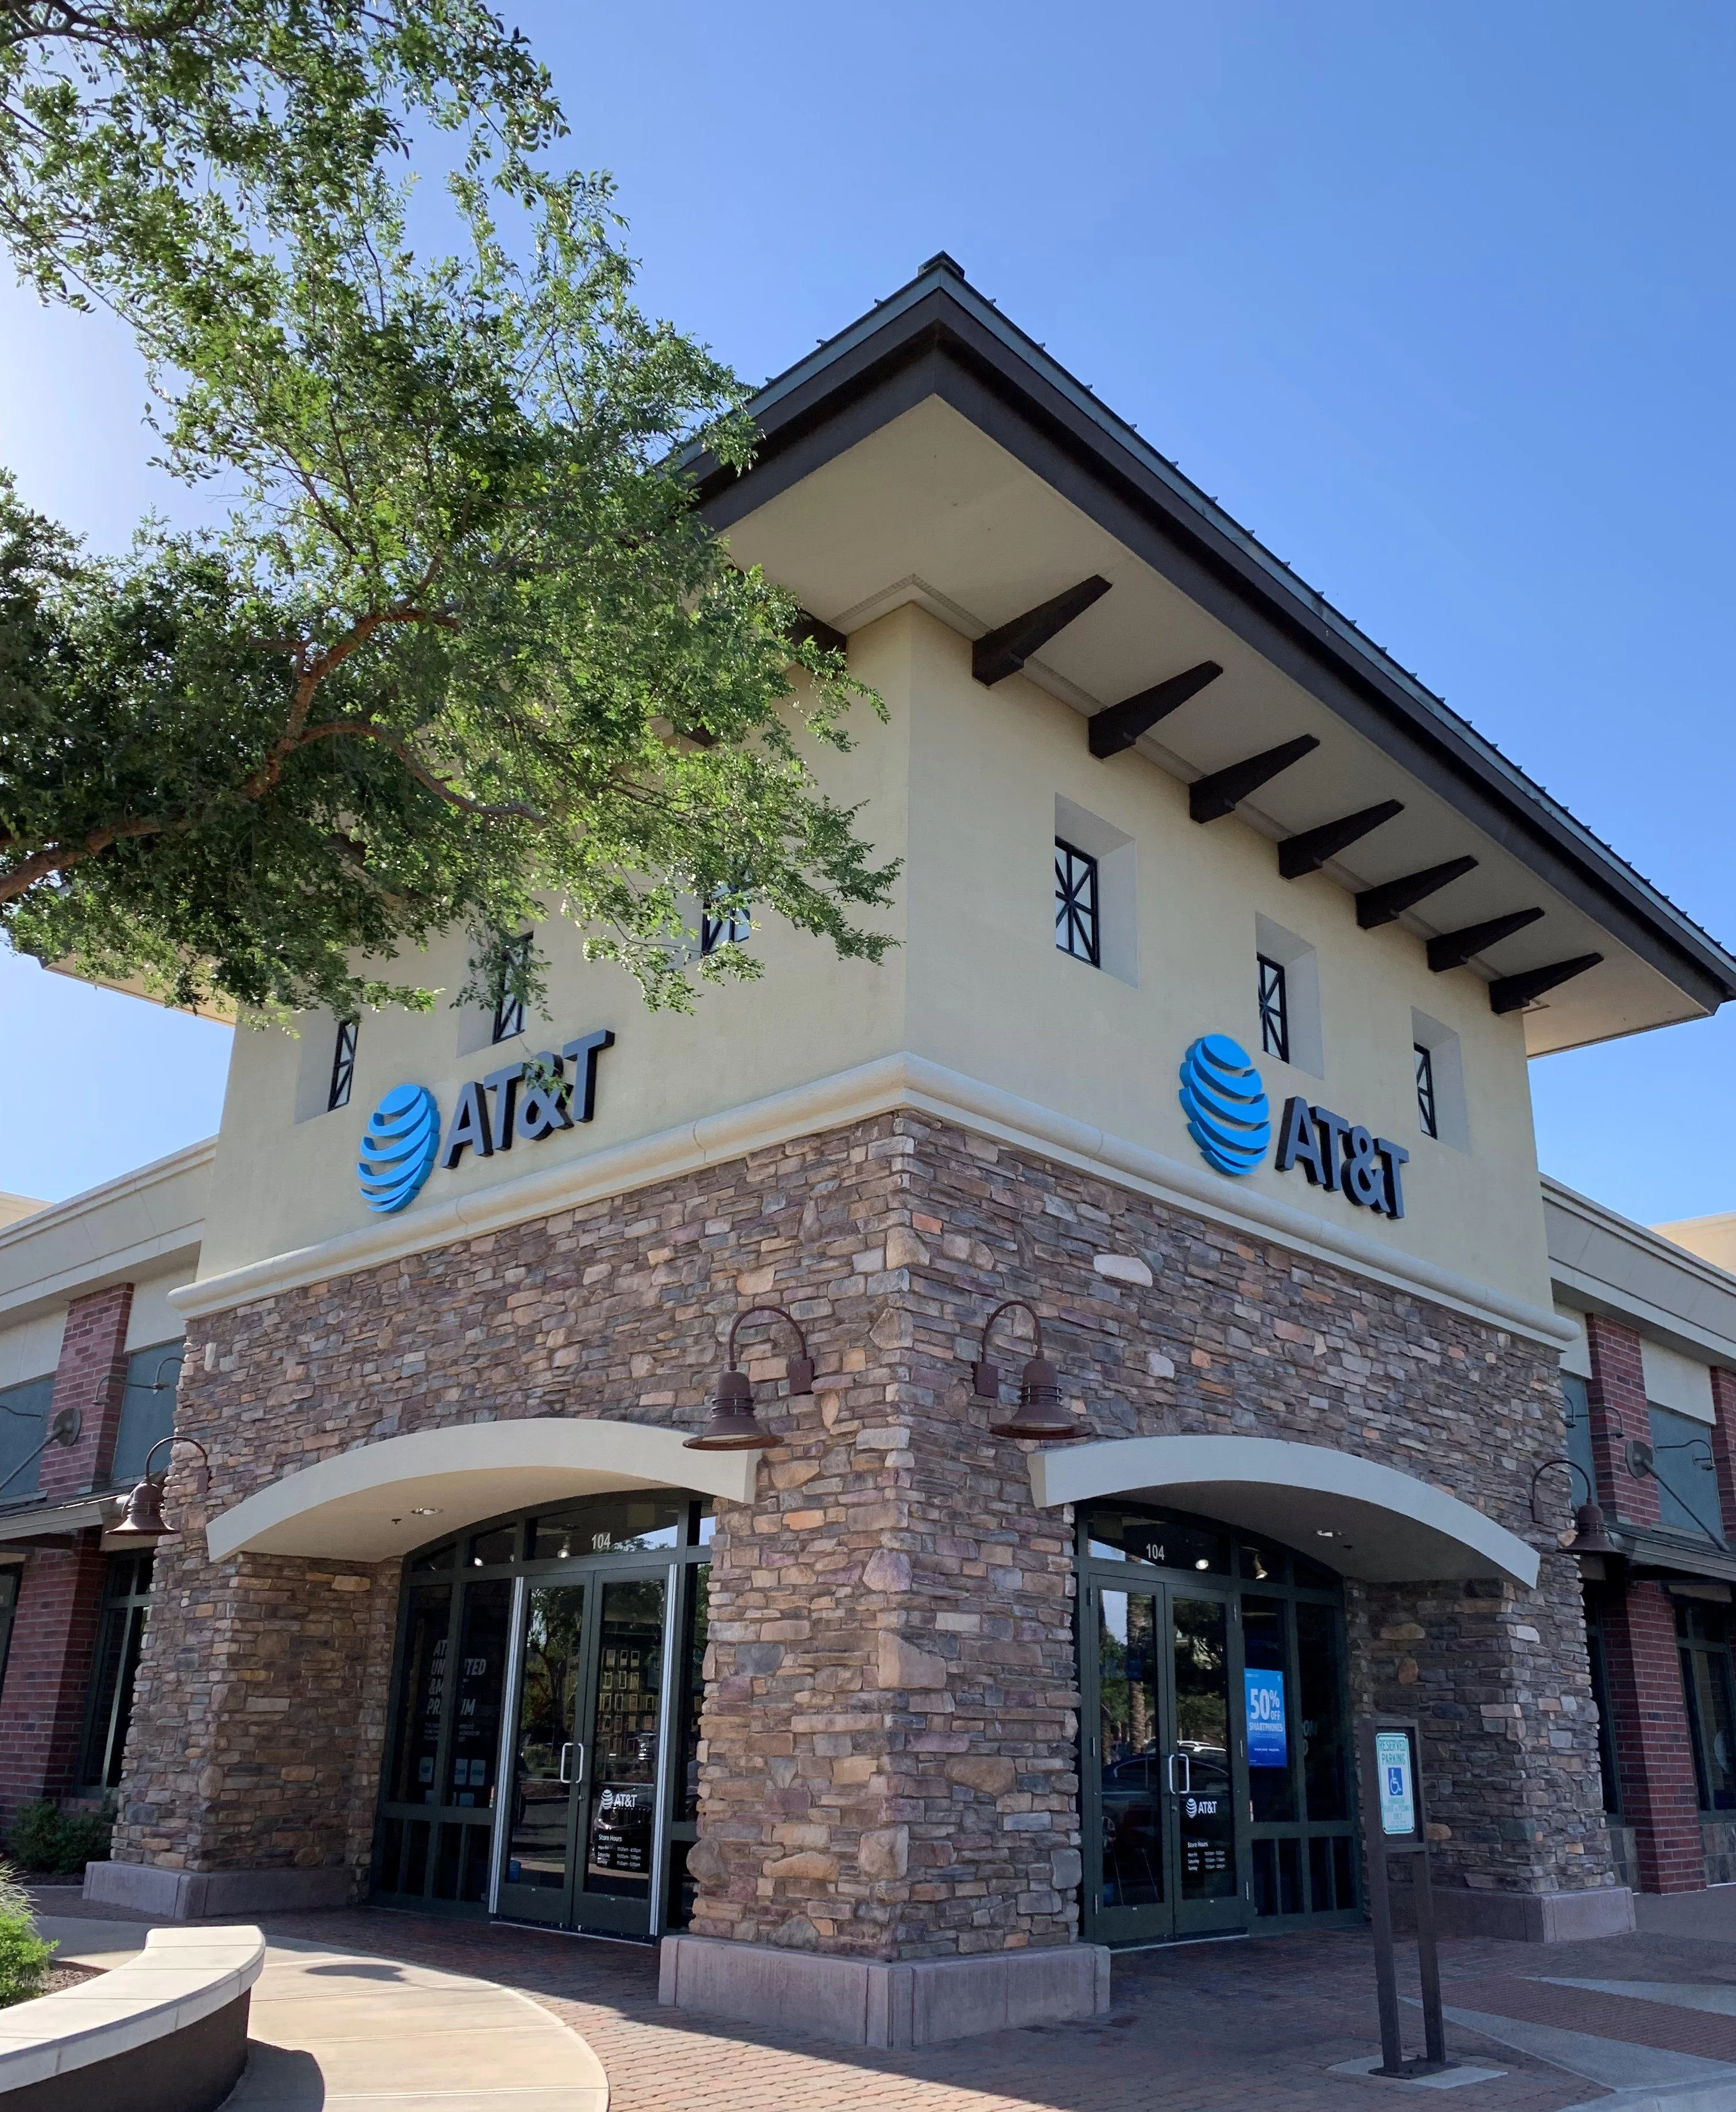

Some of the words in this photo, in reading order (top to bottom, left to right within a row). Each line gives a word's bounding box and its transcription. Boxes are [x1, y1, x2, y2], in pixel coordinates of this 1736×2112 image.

[440, 1029, 615, 1169] AT&T
[1274, 1096, 1409, 1220] AT&T
[591, 1532, 611, 1550] 104
[1146, 1544, 1165, 1560] 104
[1250, 1688, 1280, 1720] 50%
[1270, 1711, 1281, 1720] OFF
[1378, 1740, 1406, 1751] RESERVED
[1382, 1753, 1406, 1765] PARKING
[614, 1793, 638, 1808] AT&T
[1198, 1801, 1218, 1814] AT&T
